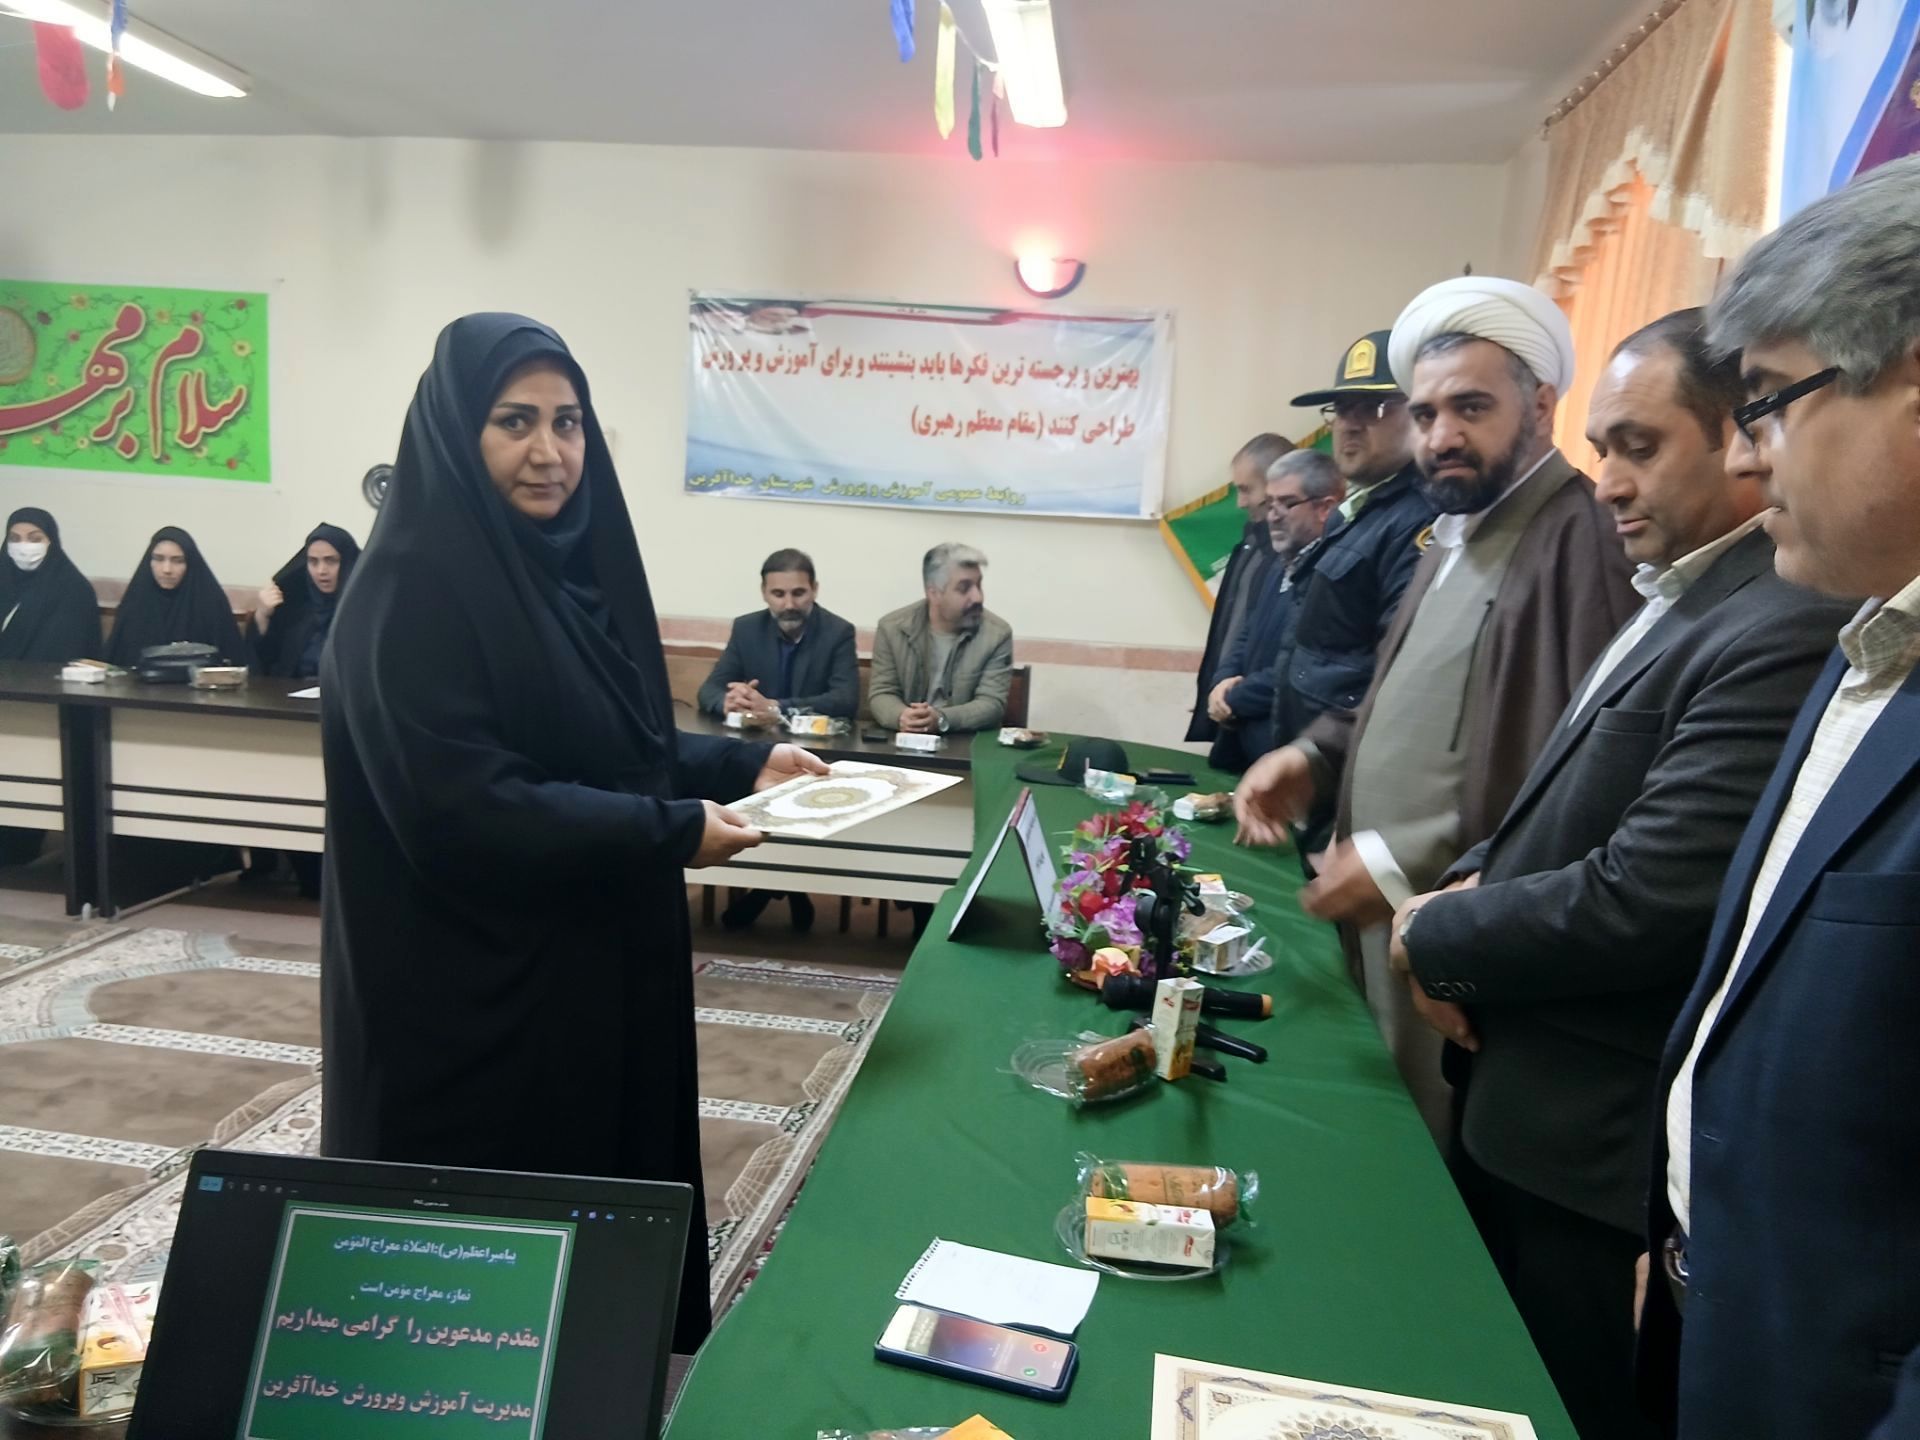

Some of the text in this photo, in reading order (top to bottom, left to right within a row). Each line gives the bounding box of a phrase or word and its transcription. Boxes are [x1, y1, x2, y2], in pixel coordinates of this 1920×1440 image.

[753, 351, 764, 372] و
[766, 342, 818, 374] آموزش
[820, 346, 853, 377] برای
[855, 356, 865, 378] و
[868, 350, 916, 380] بنشینند
[919, 352, 946, 381] باید
[991, 357, 1026, 386] ترین
[1028, 361, 1079, 389] برجسته
[1081, 368, 1090, 390] و
[1093, 362, 1140, 391] بهترین
[150, 324, 248, 461] سلام
[90, 386, 139, 460] بر
[911, 405, 1136, 445] طراحی کنند (مقام معظم رهبری)
[881, 481, 934, 500] آموزش
[935, 488, 983, 502] عمومی
[985, 485, 1026, 506] روابط
[370, 1238, 401, 1254] معراج
[360, 1281, 384, 1293] است
[413, 1286, 444, 1302] معراج
[342, 1314, 399, 1340] گرامی
[407, 1317, 421, 1344] را
[426, 1325, 492, 1347] مدعوین
[496, 1328, 540, 1350] مقدم
[262, 1374, 340, 1399] خداآفرین
[409, 1390, 470, 1415] آموزش
[472, 1397, 532, 1421] مدیریت
